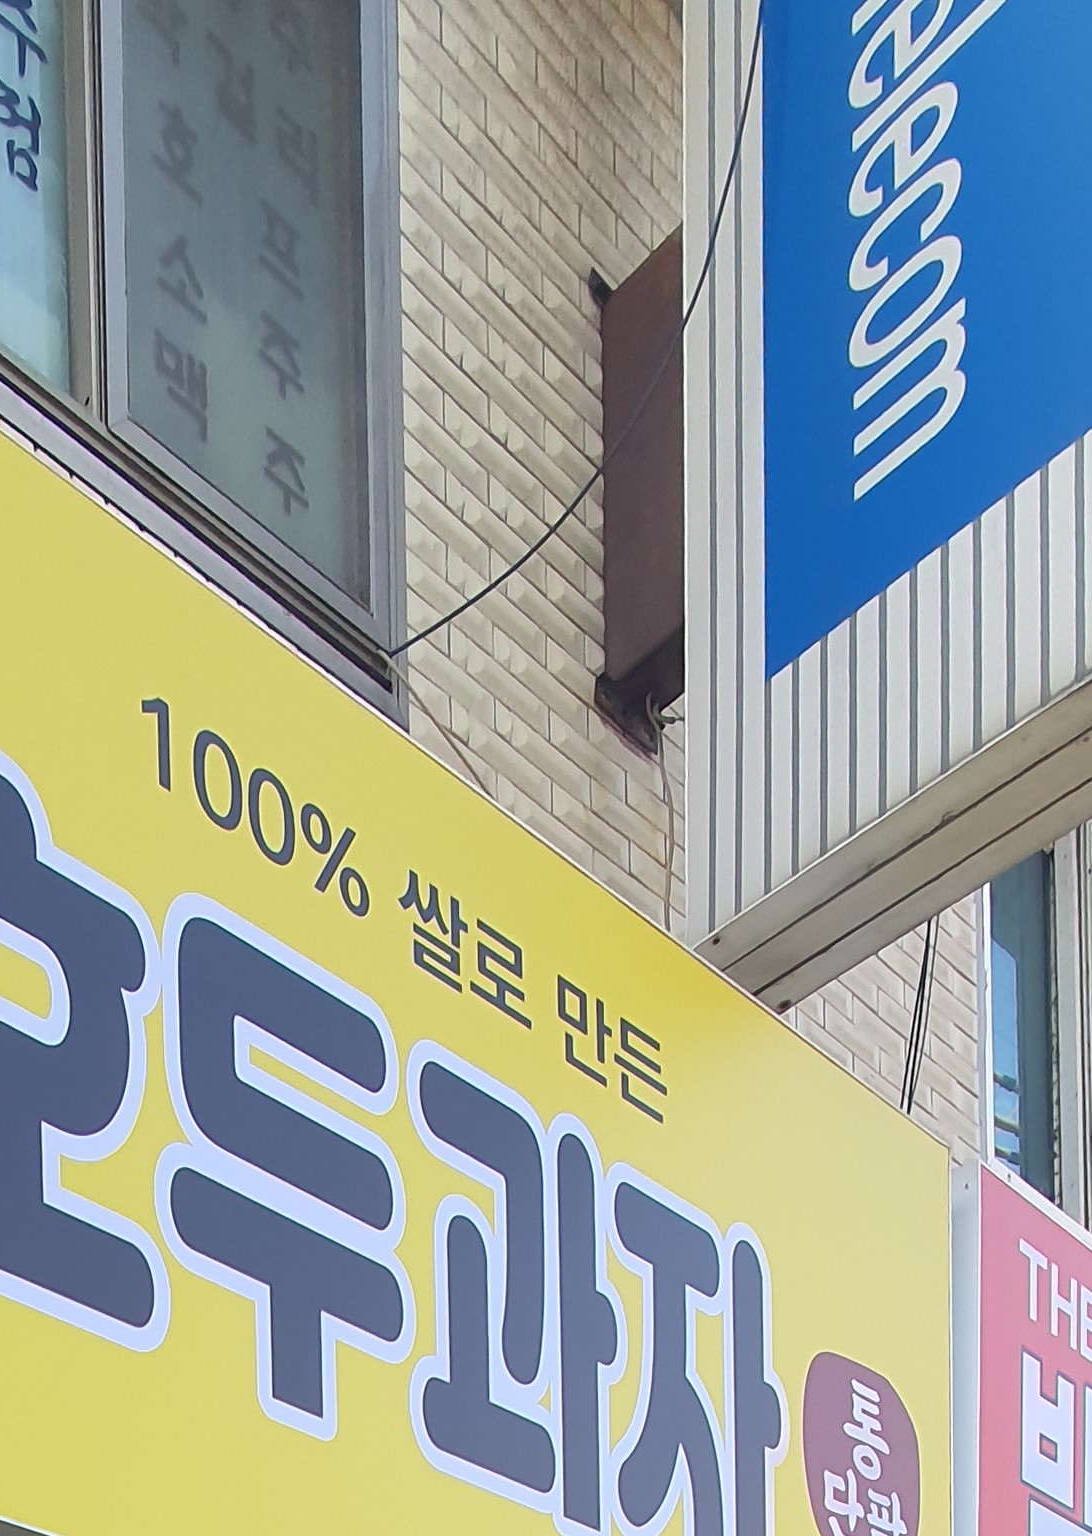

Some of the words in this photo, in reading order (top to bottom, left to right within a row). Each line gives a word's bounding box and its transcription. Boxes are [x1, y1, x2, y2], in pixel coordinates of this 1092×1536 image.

[848, 0, 1009, 501] elecom
[140, 697, 370, 918] 100%
[399, 868, 534, 1030] 쌀로
[557, 973, 668, 1124] 만든
